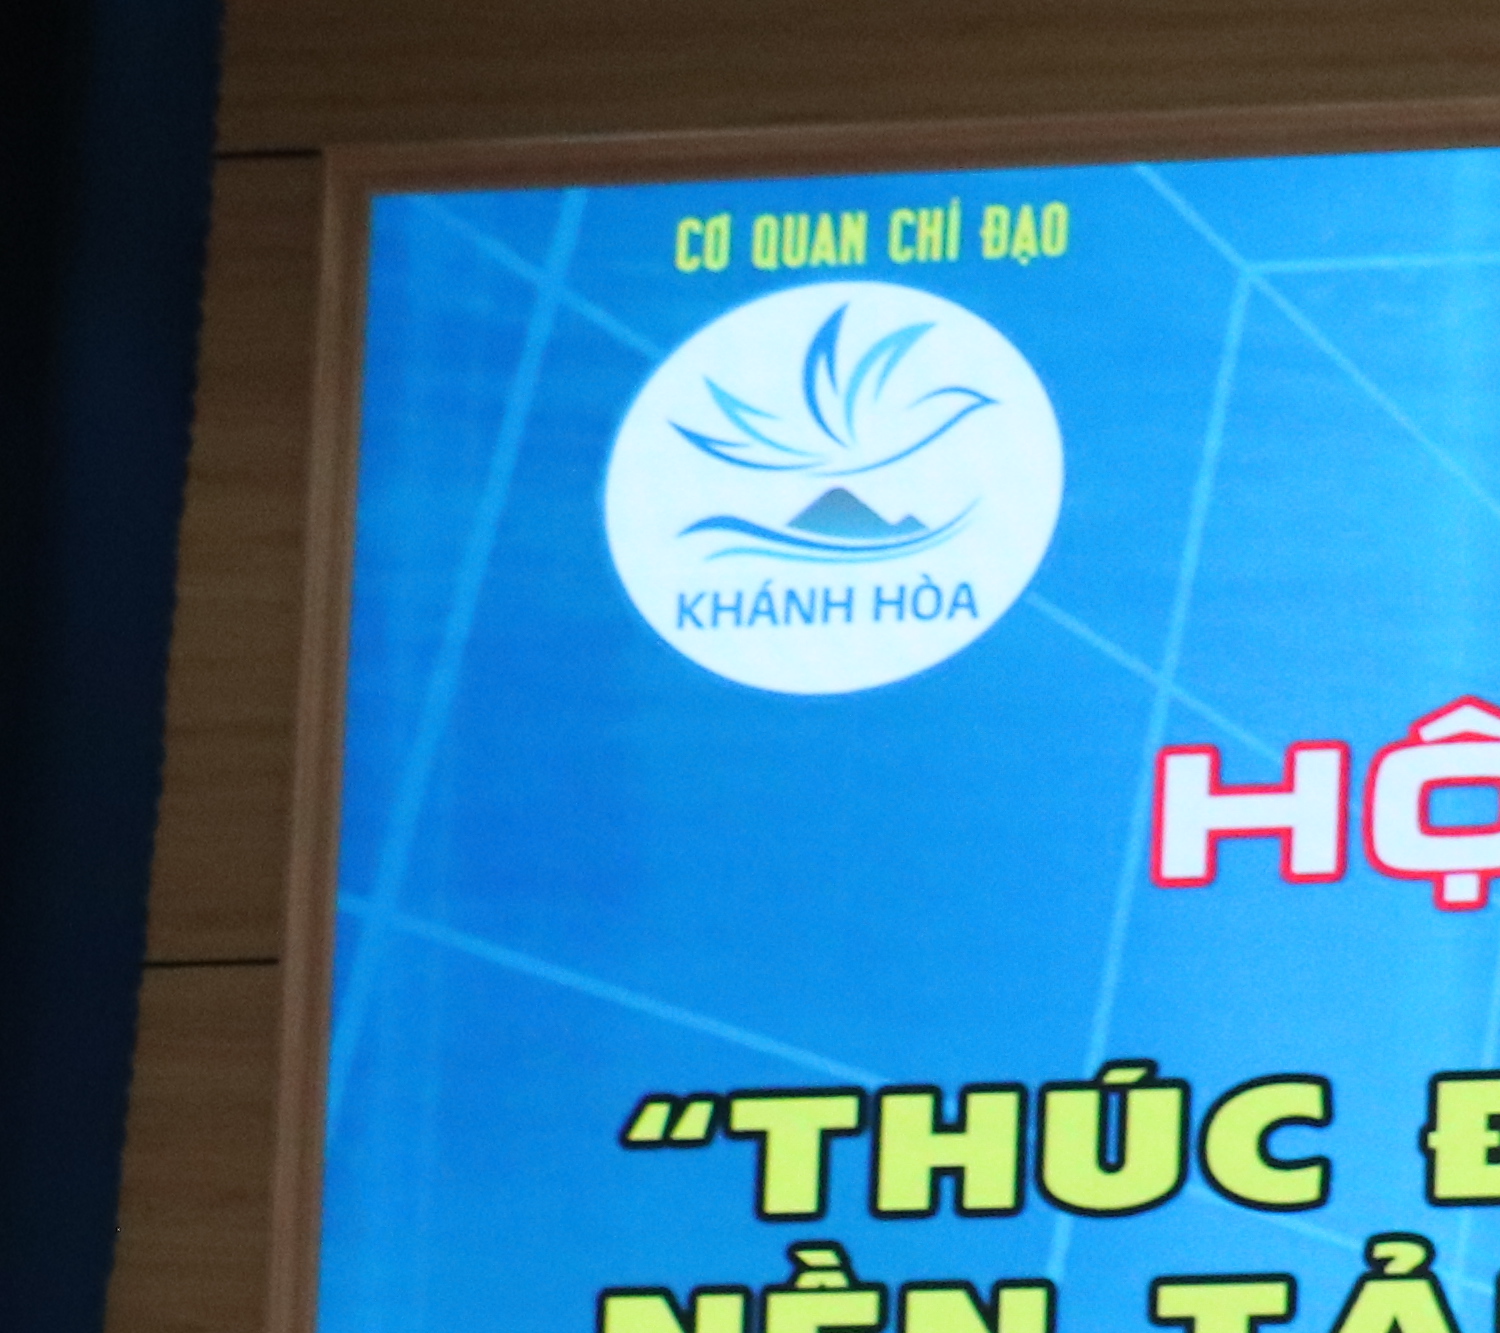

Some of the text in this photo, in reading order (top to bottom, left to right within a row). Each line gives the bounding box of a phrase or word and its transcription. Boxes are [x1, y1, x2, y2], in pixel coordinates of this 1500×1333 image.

[675, 212, 732, 273] CƠ
[751, 211, 868, 270] QUAN
[980, 201, 1069, 267] ĐẠO
[673, 568, 981, 633] KHÁNH HÒA
[621, 1061, 1333, 1222] “THÚC
